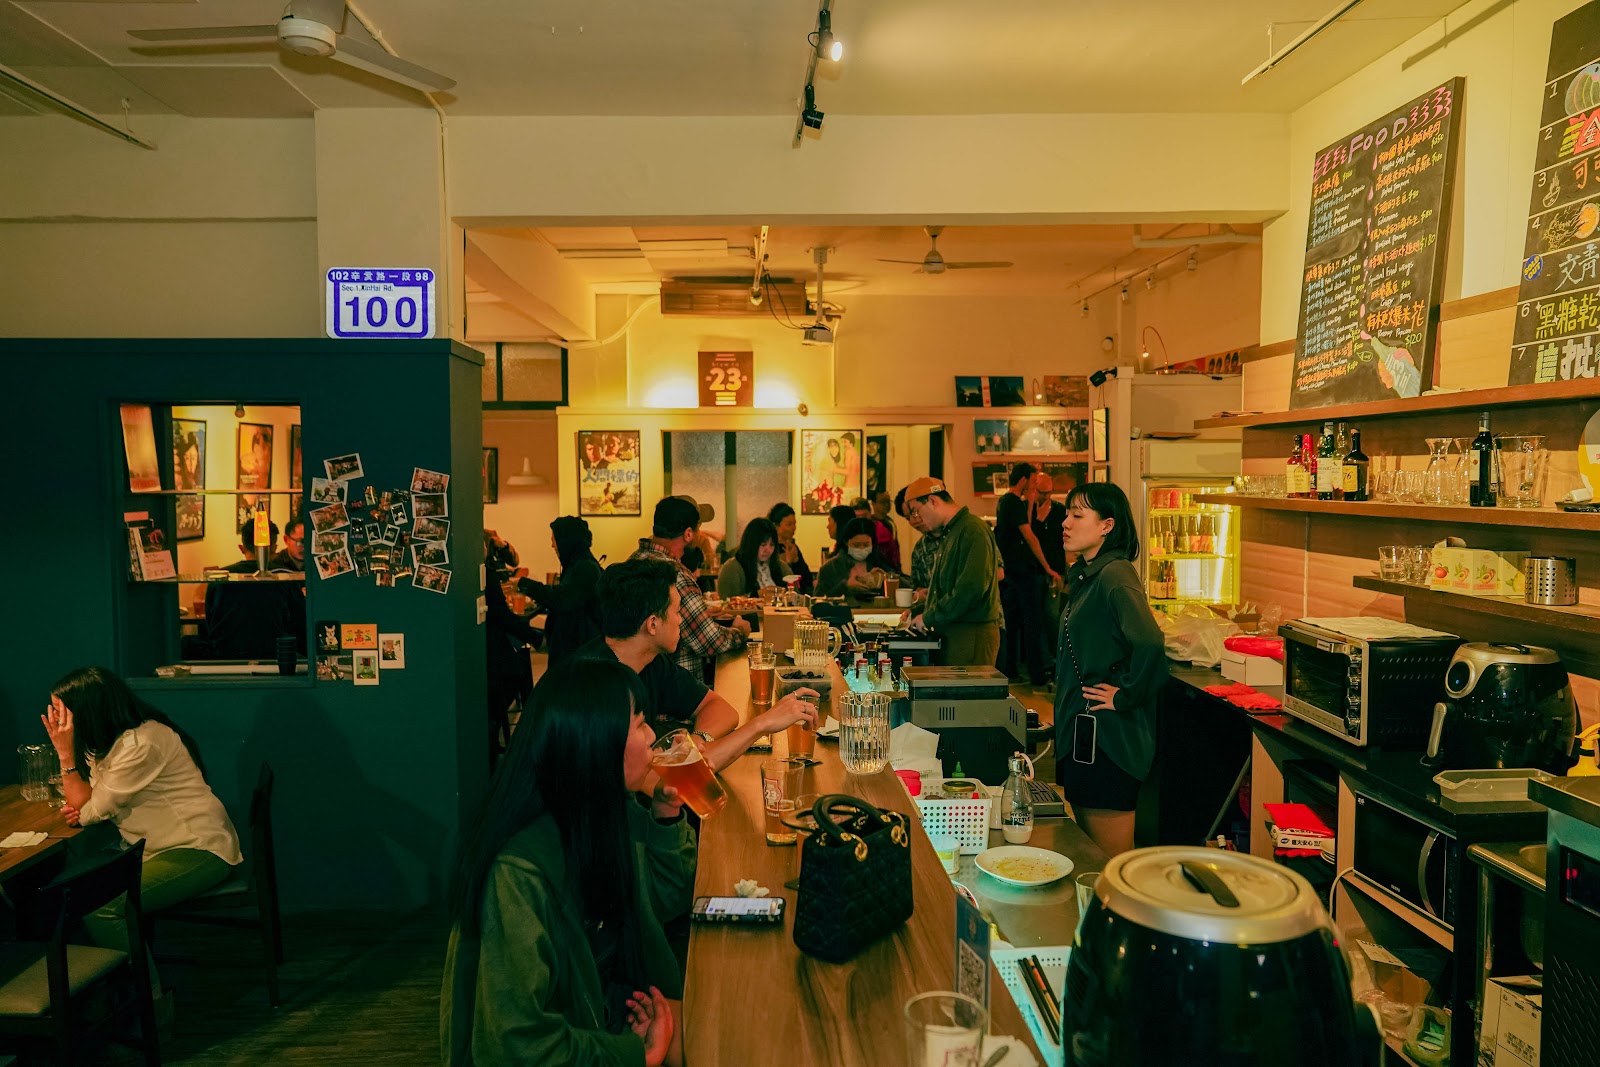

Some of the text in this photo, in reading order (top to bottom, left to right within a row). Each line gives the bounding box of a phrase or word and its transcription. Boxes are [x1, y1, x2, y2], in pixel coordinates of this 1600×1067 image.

[1550, 82, 1558, 98] 1
[1348, 118, 1407, 164] FOOD
[1544, 128, 1553, 140] 2
[1538, 172, 1546, 188] 3
[1532, 217, 1540, 230] 4
[1524, 256, 1539, 275] SOLD
[1528, 262, 1540, 279] OUT
[331, 271, 428, 281] 102 辛亥路一段 98
[346, 296, 416, 328] 100
[1367, 300, 1425, 332] 有梗爆米花
[1521, 302, 1530, 318] 6
[1535, 293, 1600, 340] 黑糖乾
[1518, 347, 1526, 360] 7
[1535, 336, 1600, 384] 信批
[709, 368, 742, 391] 23
